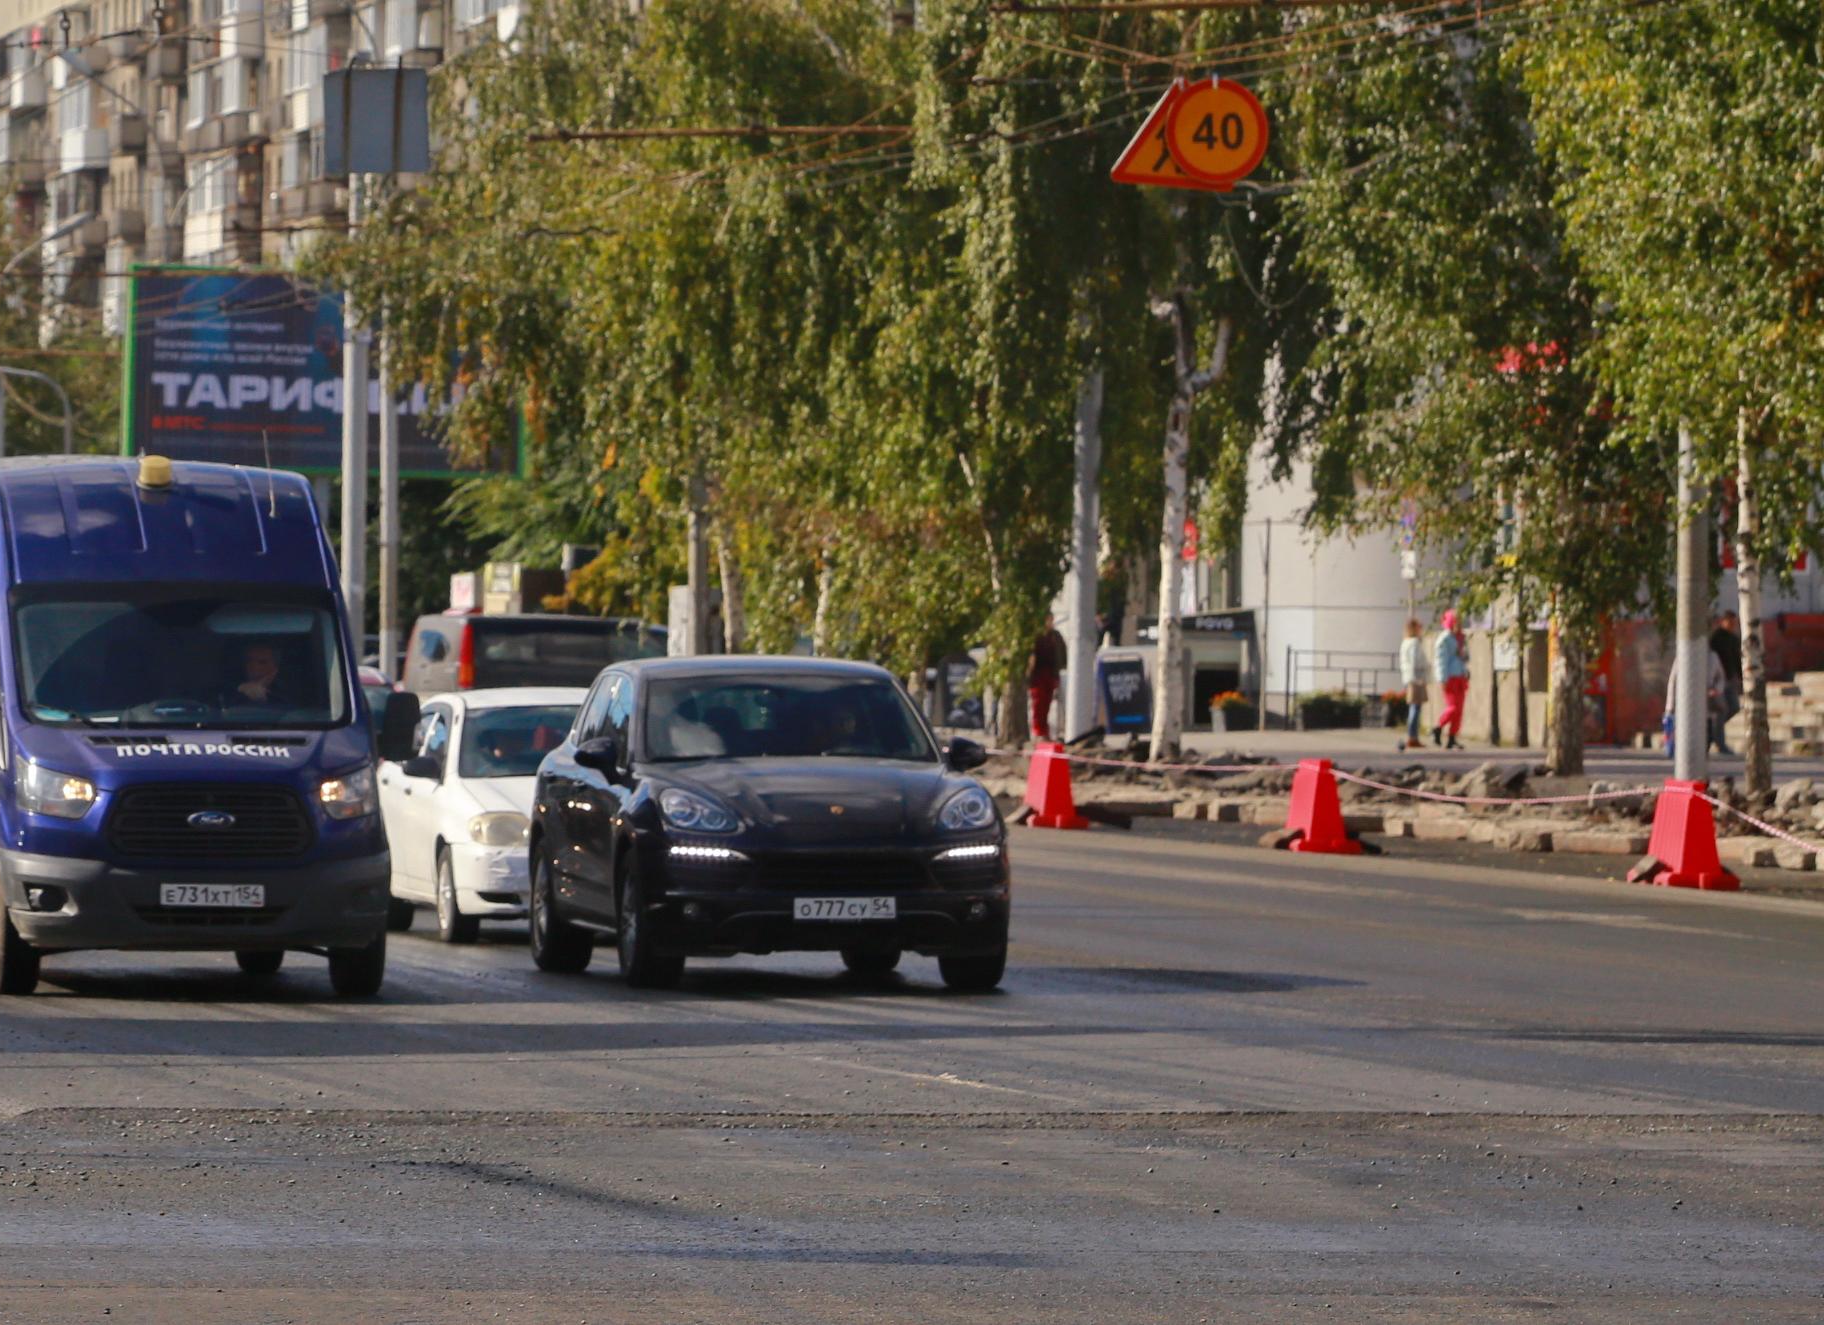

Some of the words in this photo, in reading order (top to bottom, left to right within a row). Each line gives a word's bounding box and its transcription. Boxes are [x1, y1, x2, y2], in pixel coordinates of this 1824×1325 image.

[1192, 112, 1244, 150] 40
[115, 743, 202, 758] ПОЧТА
[203, 743, 290, 758] РОССИИ
[165, 886, 231, 904] Е731ХТ
